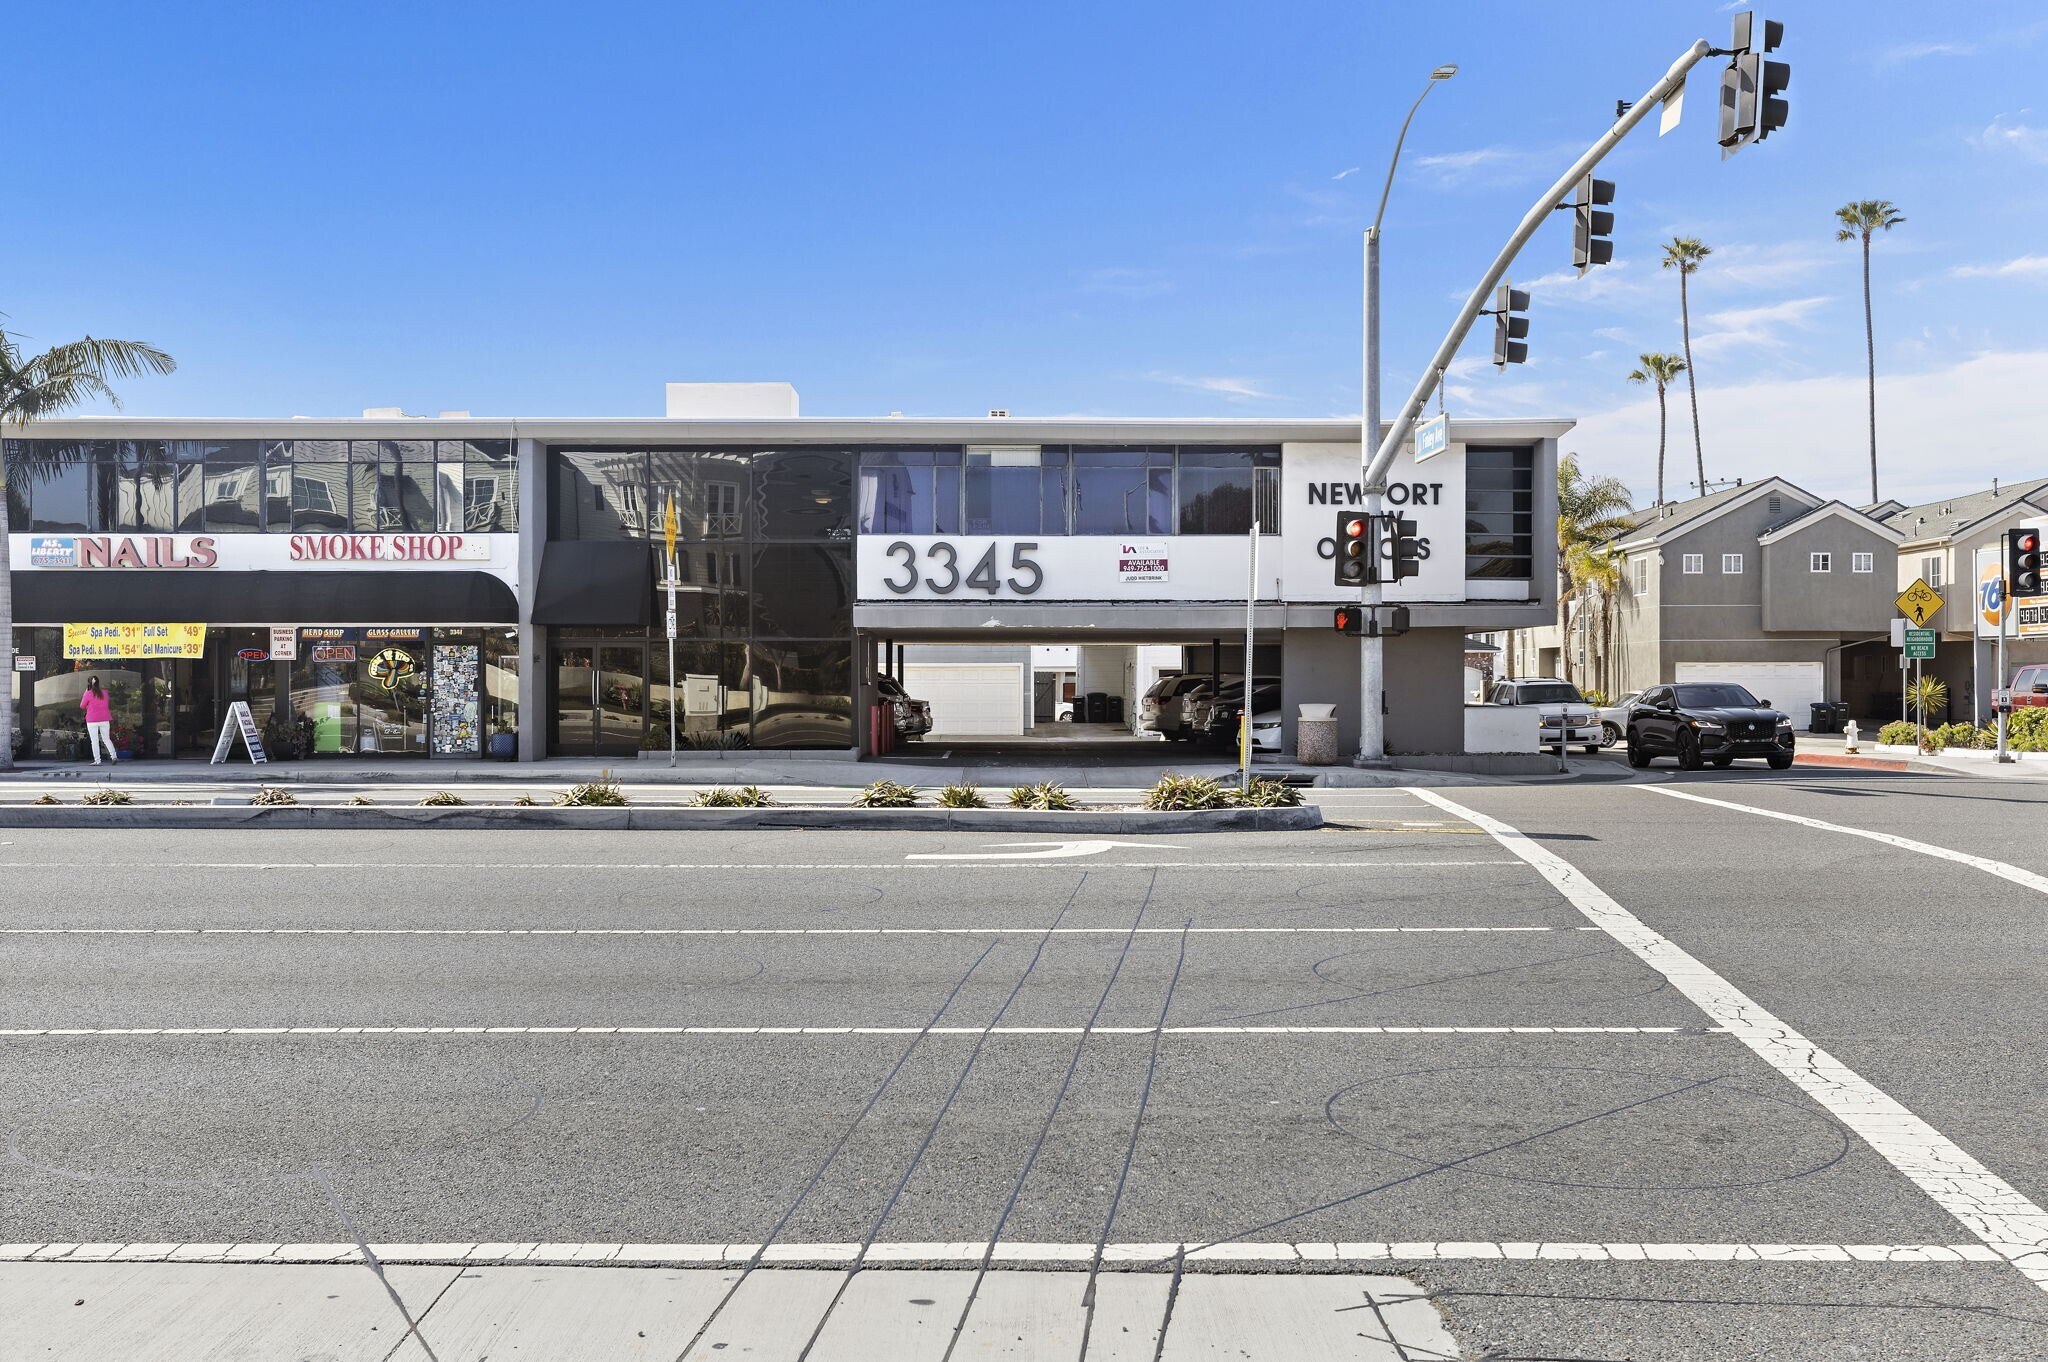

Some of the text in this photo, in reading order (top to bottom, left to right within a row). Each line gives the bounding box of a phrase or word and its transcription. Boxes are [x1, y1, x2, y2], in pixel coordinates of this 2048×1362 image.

[1308, 483, 1443, 505] NEWORT
[31, 547, 74, 556] LIBERTY
[78, 536, 218, 568] NAILS
[290, 535, 463, 561] SMOKE SHOP
[883, 541, 1044, 595] 3345
[90, 627, 103, 639] Spa
[104, 626, 121, 637] Pedi.
[144, 627, 155, 636] Full
[157, 627, 168, 636] Set
[68, 644, 80, 656] Spa
[81, 644, 97, 654] Pedi.
[104, 644, 121, 654] Mani.
[143, 643, 153, 654] Gel
[154, 643, 182, 654] Manicure
[240, 651, 267, 659] OPEN
[315, 647, 354, 660] OPEN
